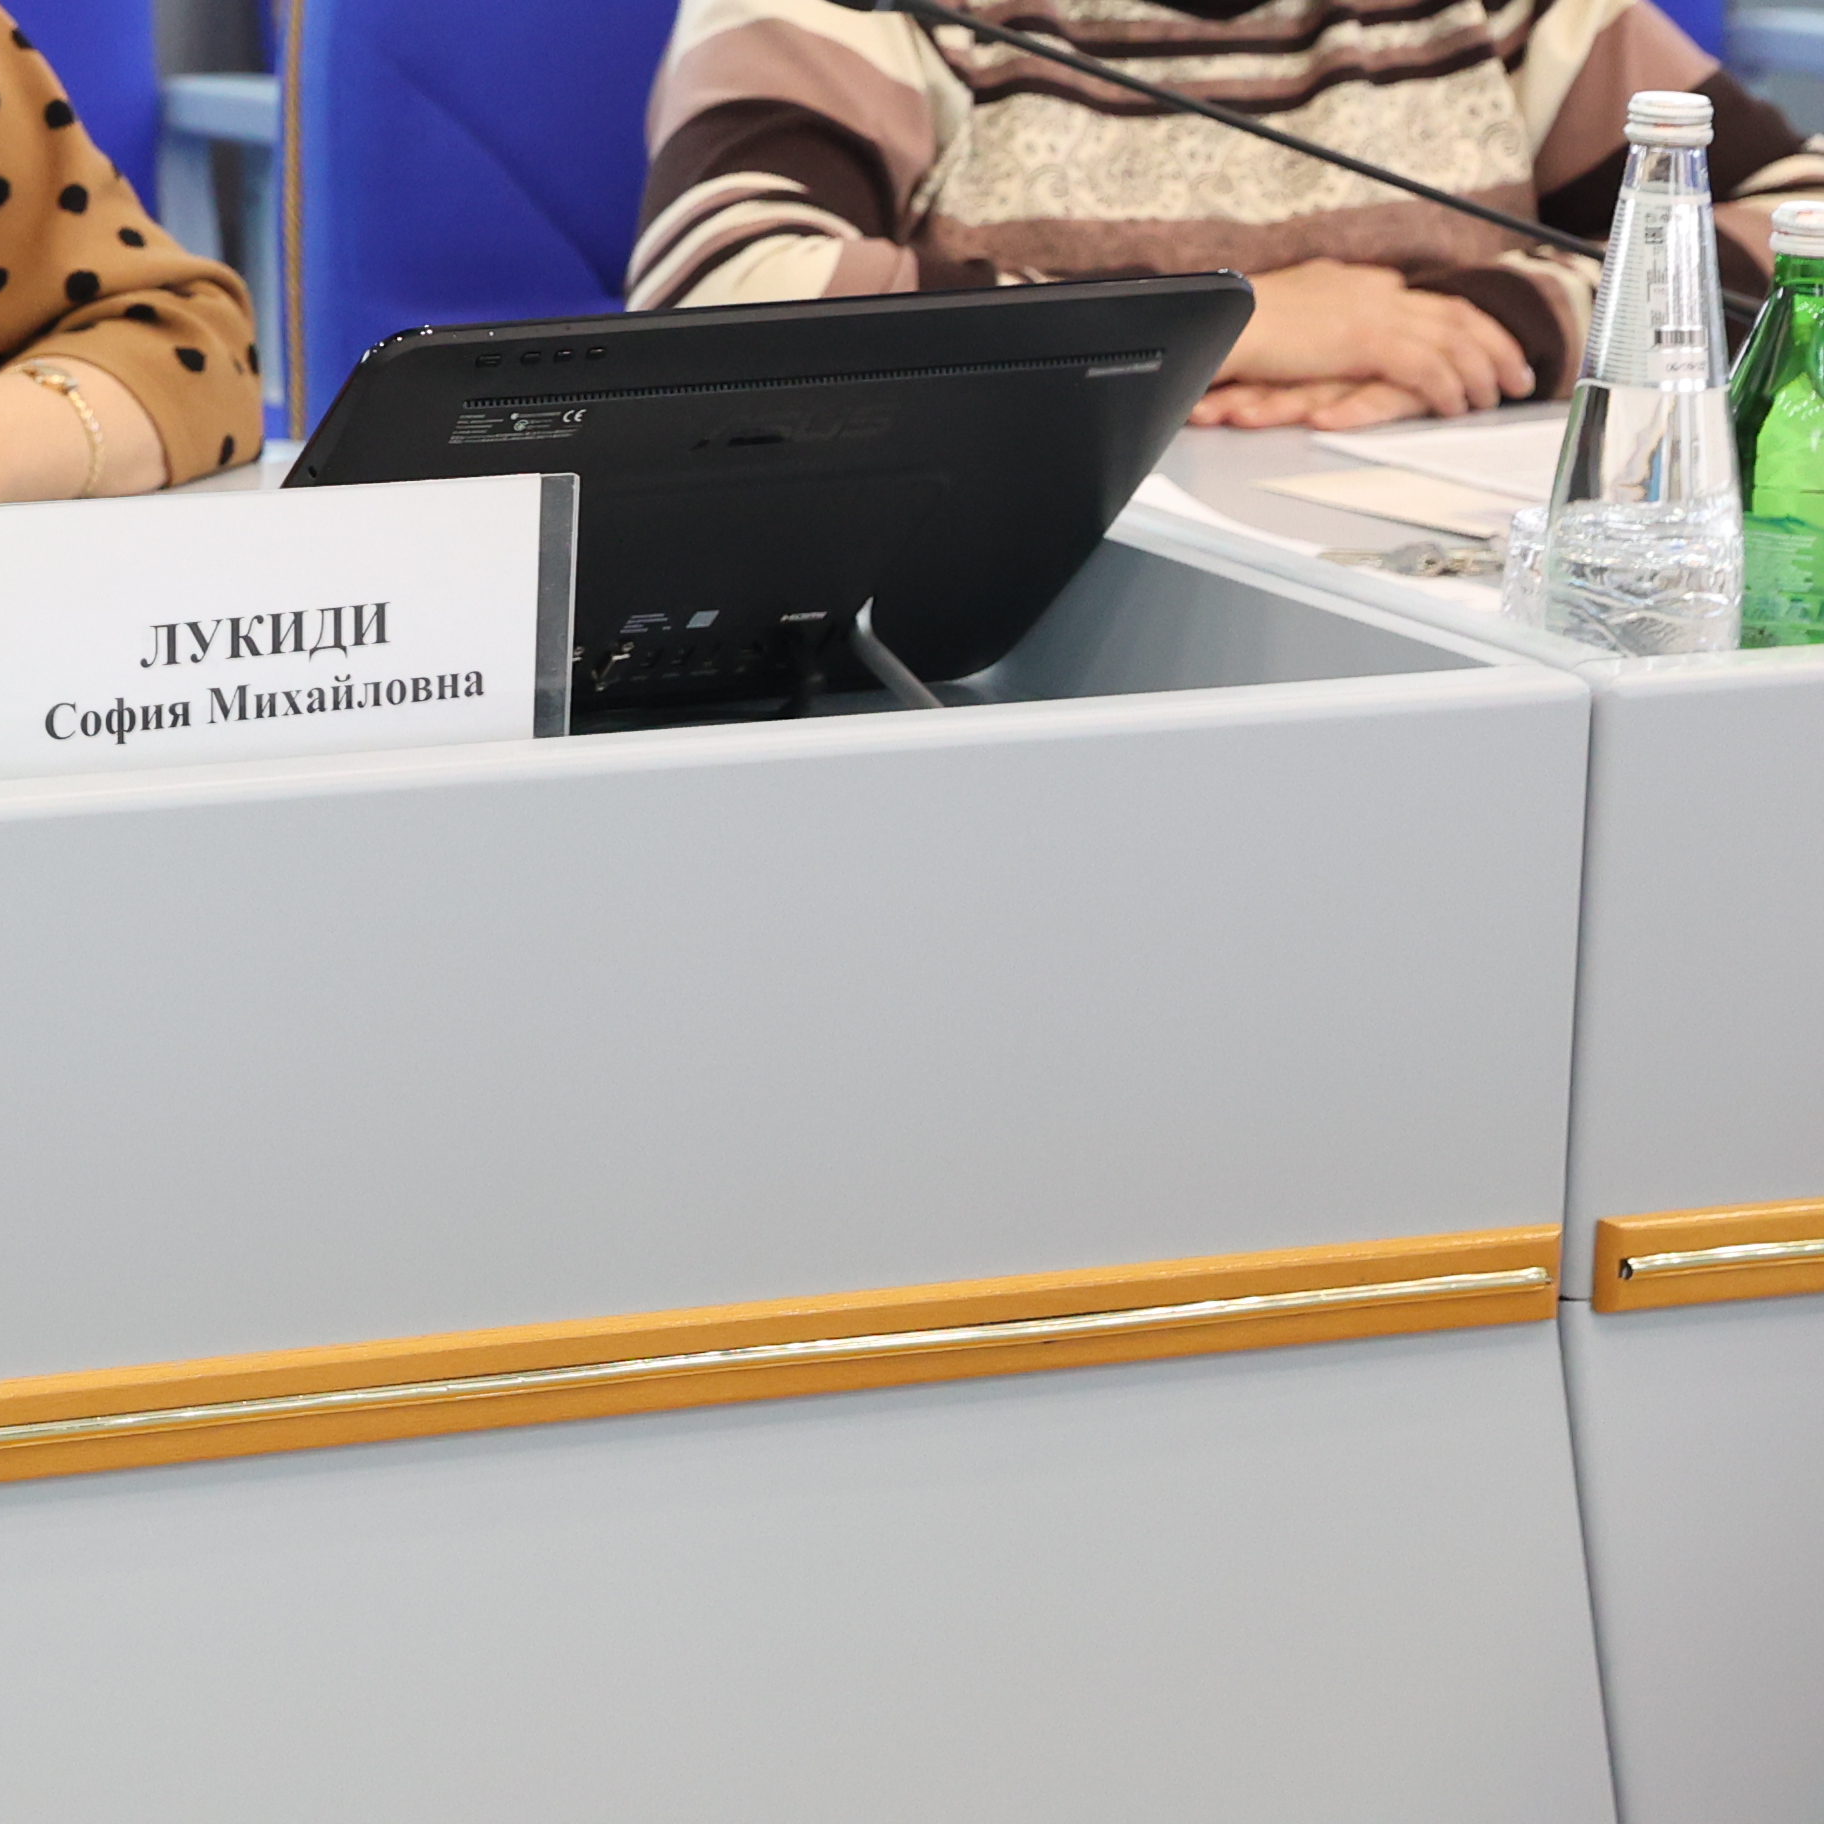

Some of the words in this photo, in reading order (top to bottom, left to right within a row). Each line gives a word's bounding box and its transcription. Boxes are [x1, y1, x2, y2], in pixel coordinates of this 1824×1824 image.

[139, 601, 390, 669] ЛУКИДИ
[44, 697, 192, 745] София
[208, 670, 485, 725] Михайловна
